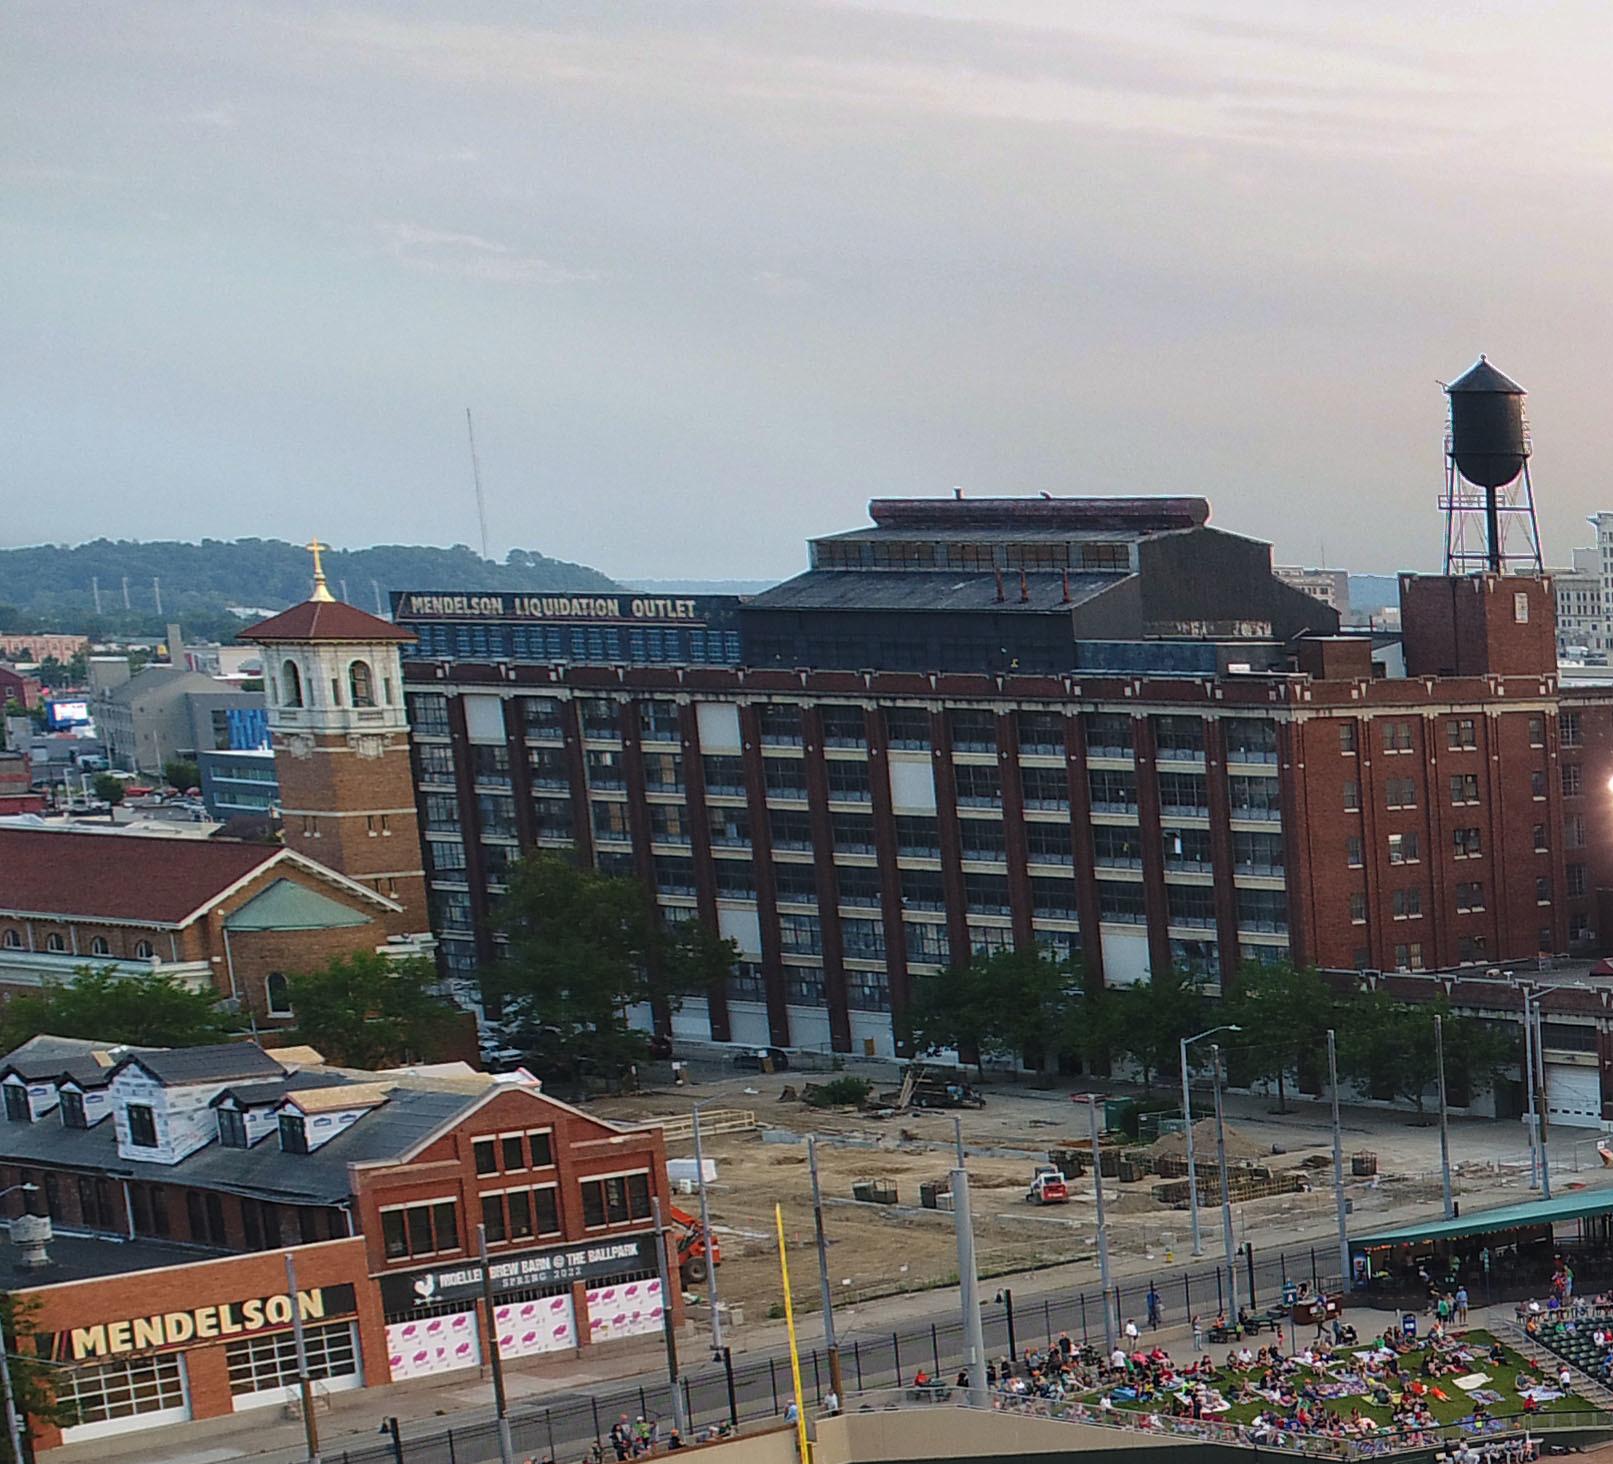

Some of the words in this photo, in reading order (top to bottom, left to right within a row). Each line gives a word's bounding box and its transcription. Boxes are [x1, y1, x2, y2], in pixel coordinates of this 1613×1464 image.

[410, 596, 504, 615] MENDELSON
[514, 597, 620, 618] LIQUIDATION
[632, 599, 696, 618] OUTLET
[489, 1262, 519, 1280] BREW
[521, 1257, 551, 1275] BARN
[565, 1252, 587, 1267] THE
[588, 1243, 639, 1263] BALLPARK
[502, 1273, 547, 1288] SPRING
[71, 1288, 324, 1359] MENDELSON
